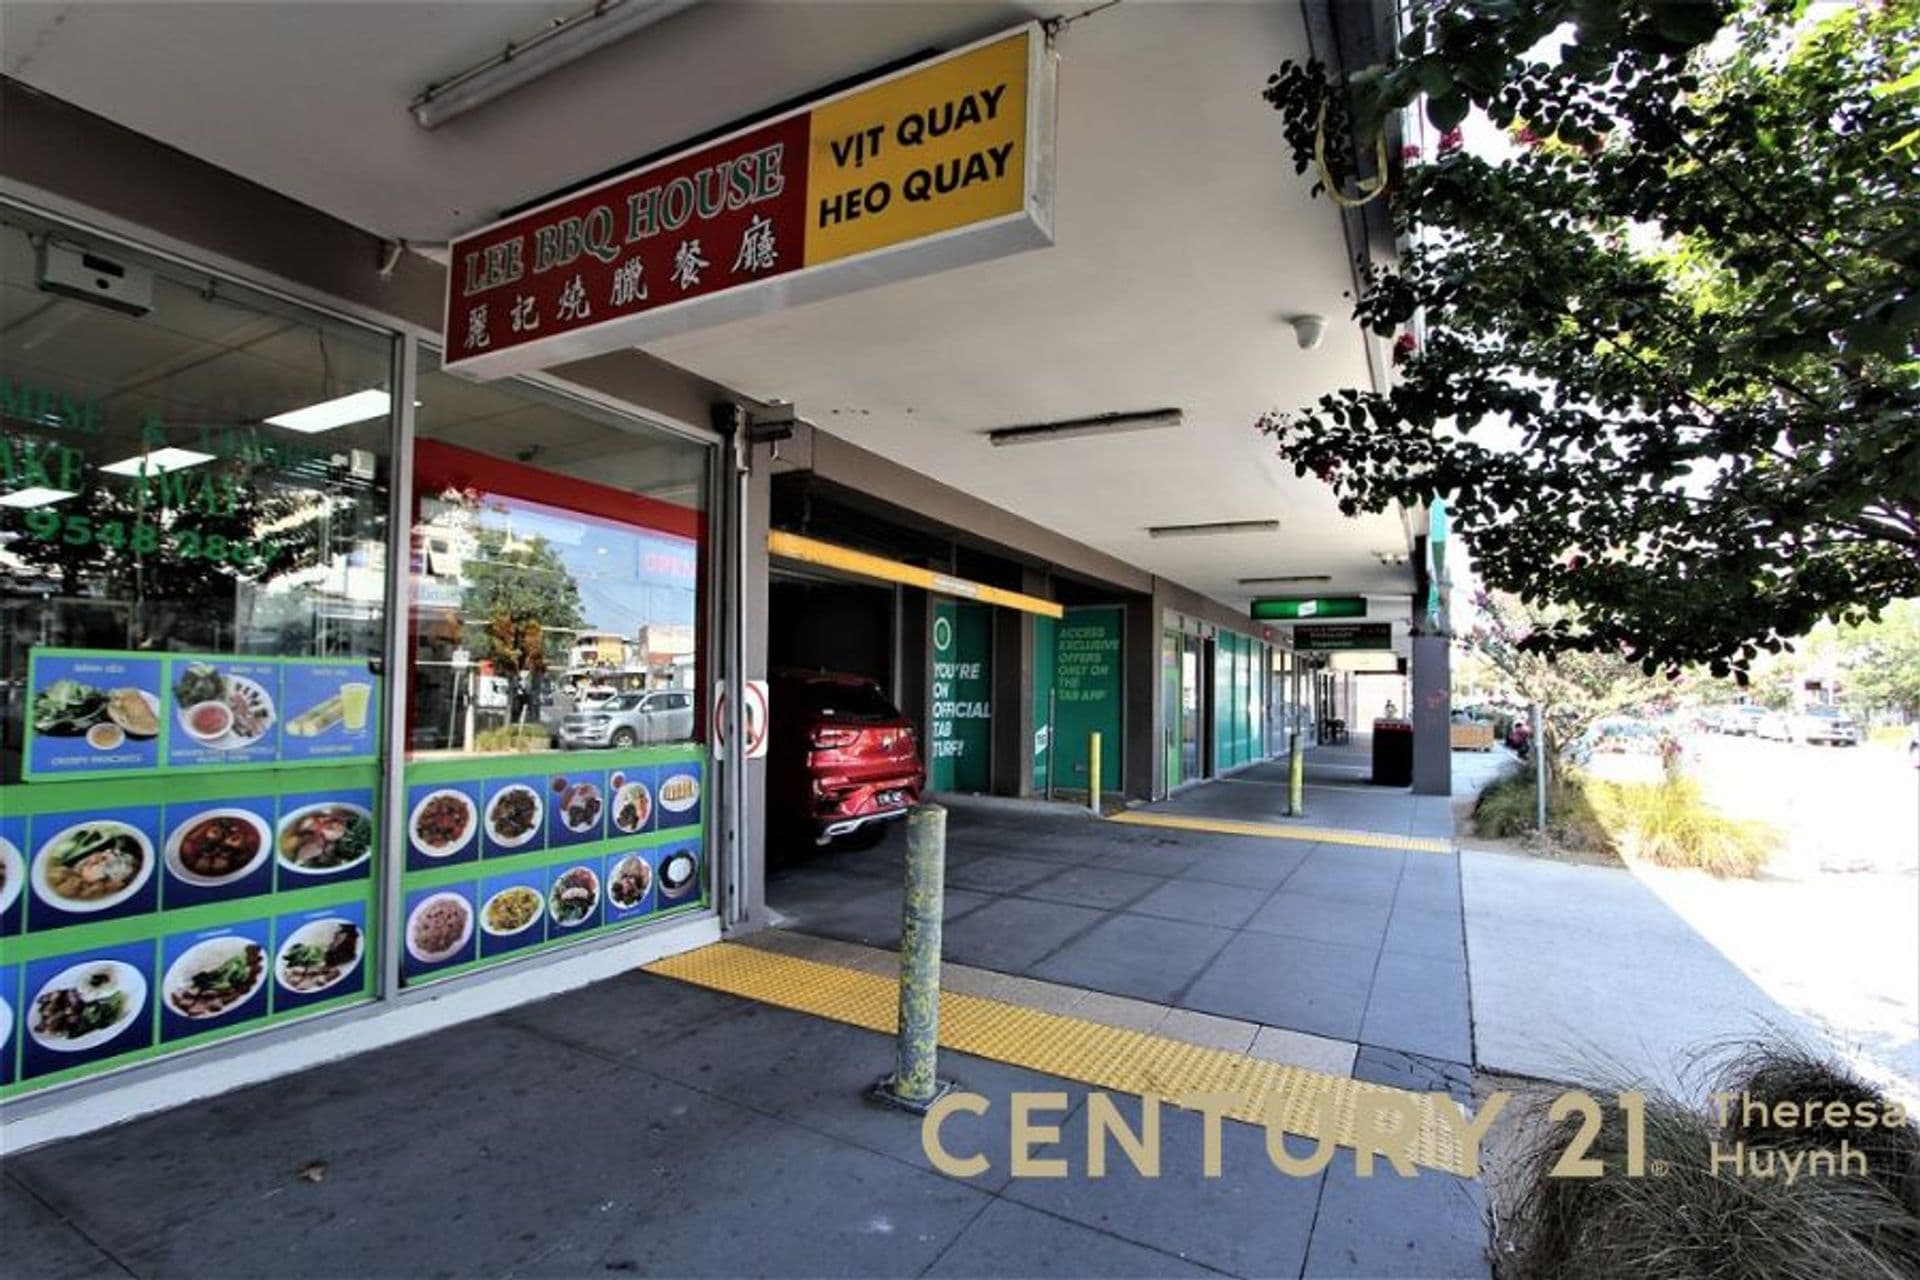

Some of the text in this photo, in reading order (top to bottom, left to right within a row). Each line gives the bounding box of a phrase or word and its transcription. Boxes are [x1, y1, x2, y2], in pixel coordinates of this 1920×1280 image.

[830, 83, 1007, 168] VỊT QUAY
[819, 141, 1015, 229] HEO QUAY
[463, 143, 786, 298] LEE BBQ HOUSE
[23, 509, 159, 555] 9548
[933, 663, 981, 680] YOU'RE
[932, 682, 950, 699] ON
[932, 701, 992, 719] OFFICIAL
[933, 721, 953, 738] TAB
